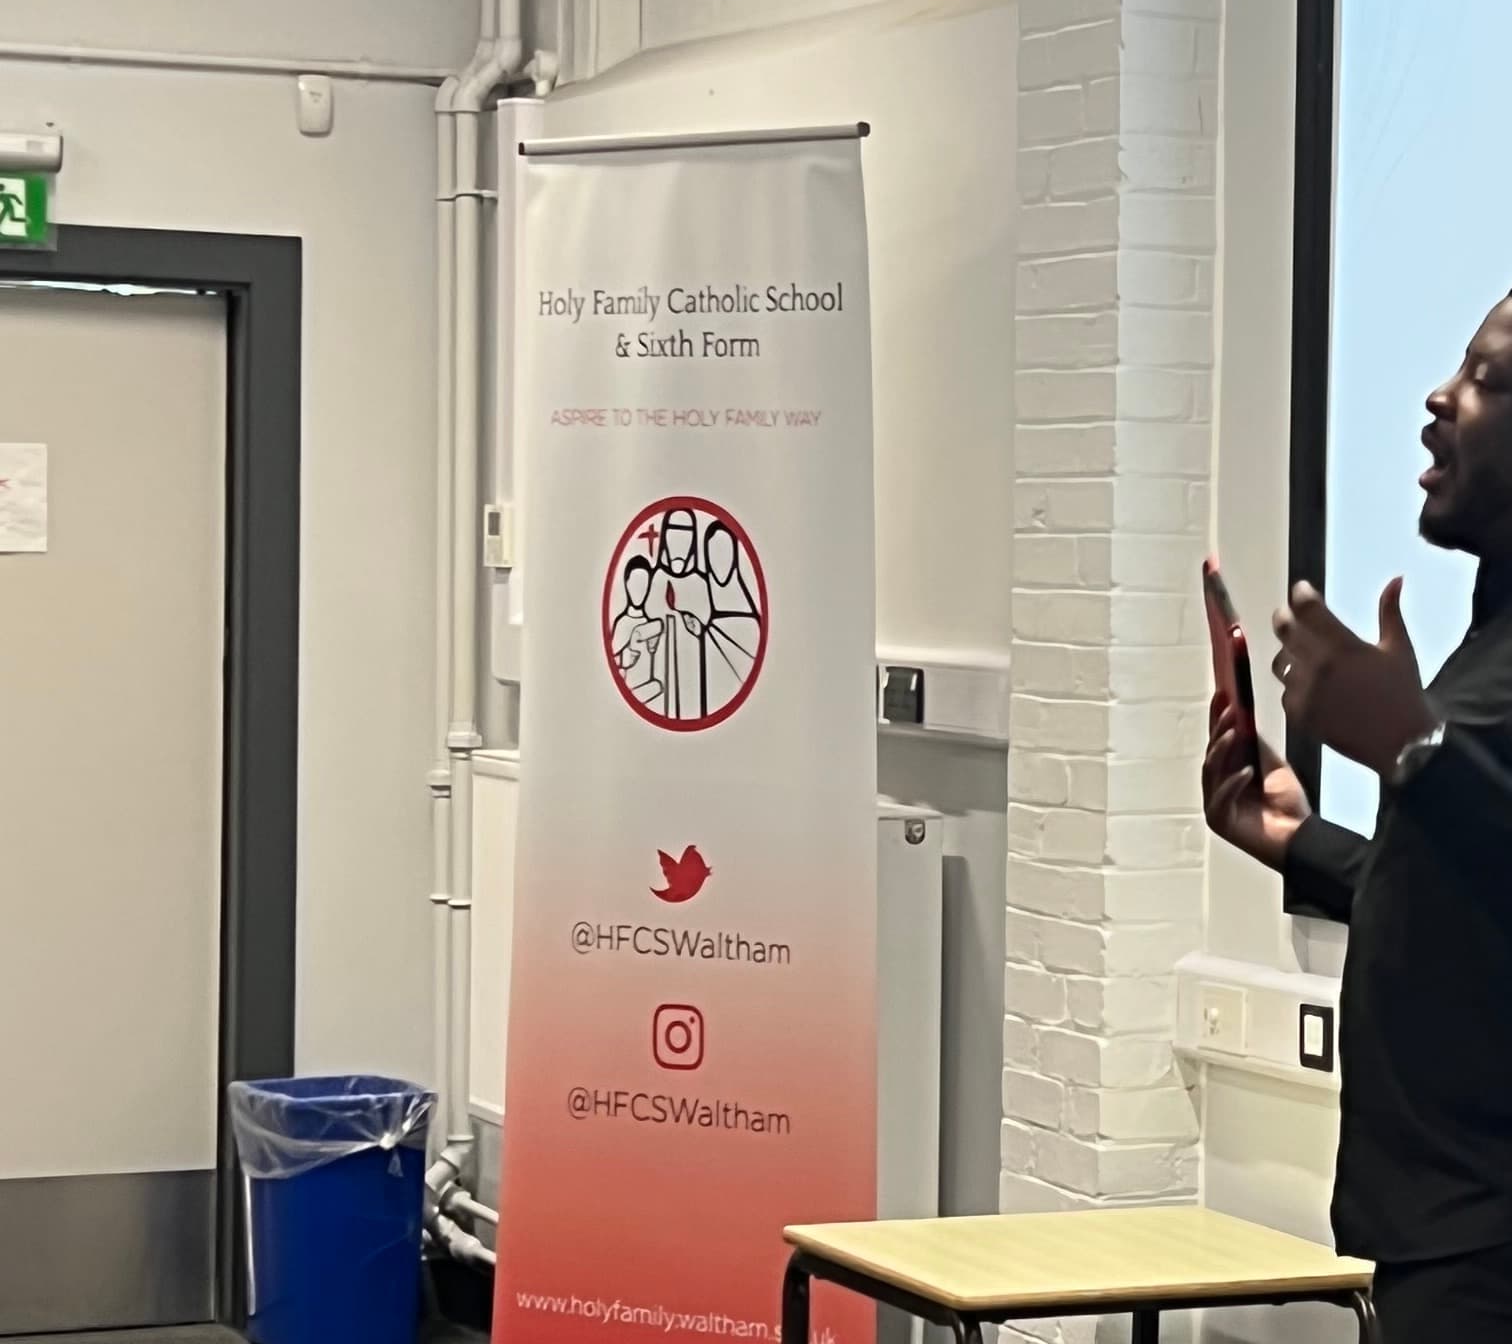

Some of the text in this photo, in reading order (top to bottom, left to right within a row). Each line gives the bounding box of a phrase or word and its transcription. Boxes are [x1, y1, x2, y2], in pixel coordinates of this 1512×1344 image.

[538, 282, 843, 323] Holy Family Catholic School
[615, 329, 760, 358] & Sixth Form
[551, 408, 822, 426] ASPIRE TO THE HOLY FAMILY WAY
[571, 921, 791, 964] @HFCSWaltham
[567, 1087, 791, 1134] @HFCSWaltham
